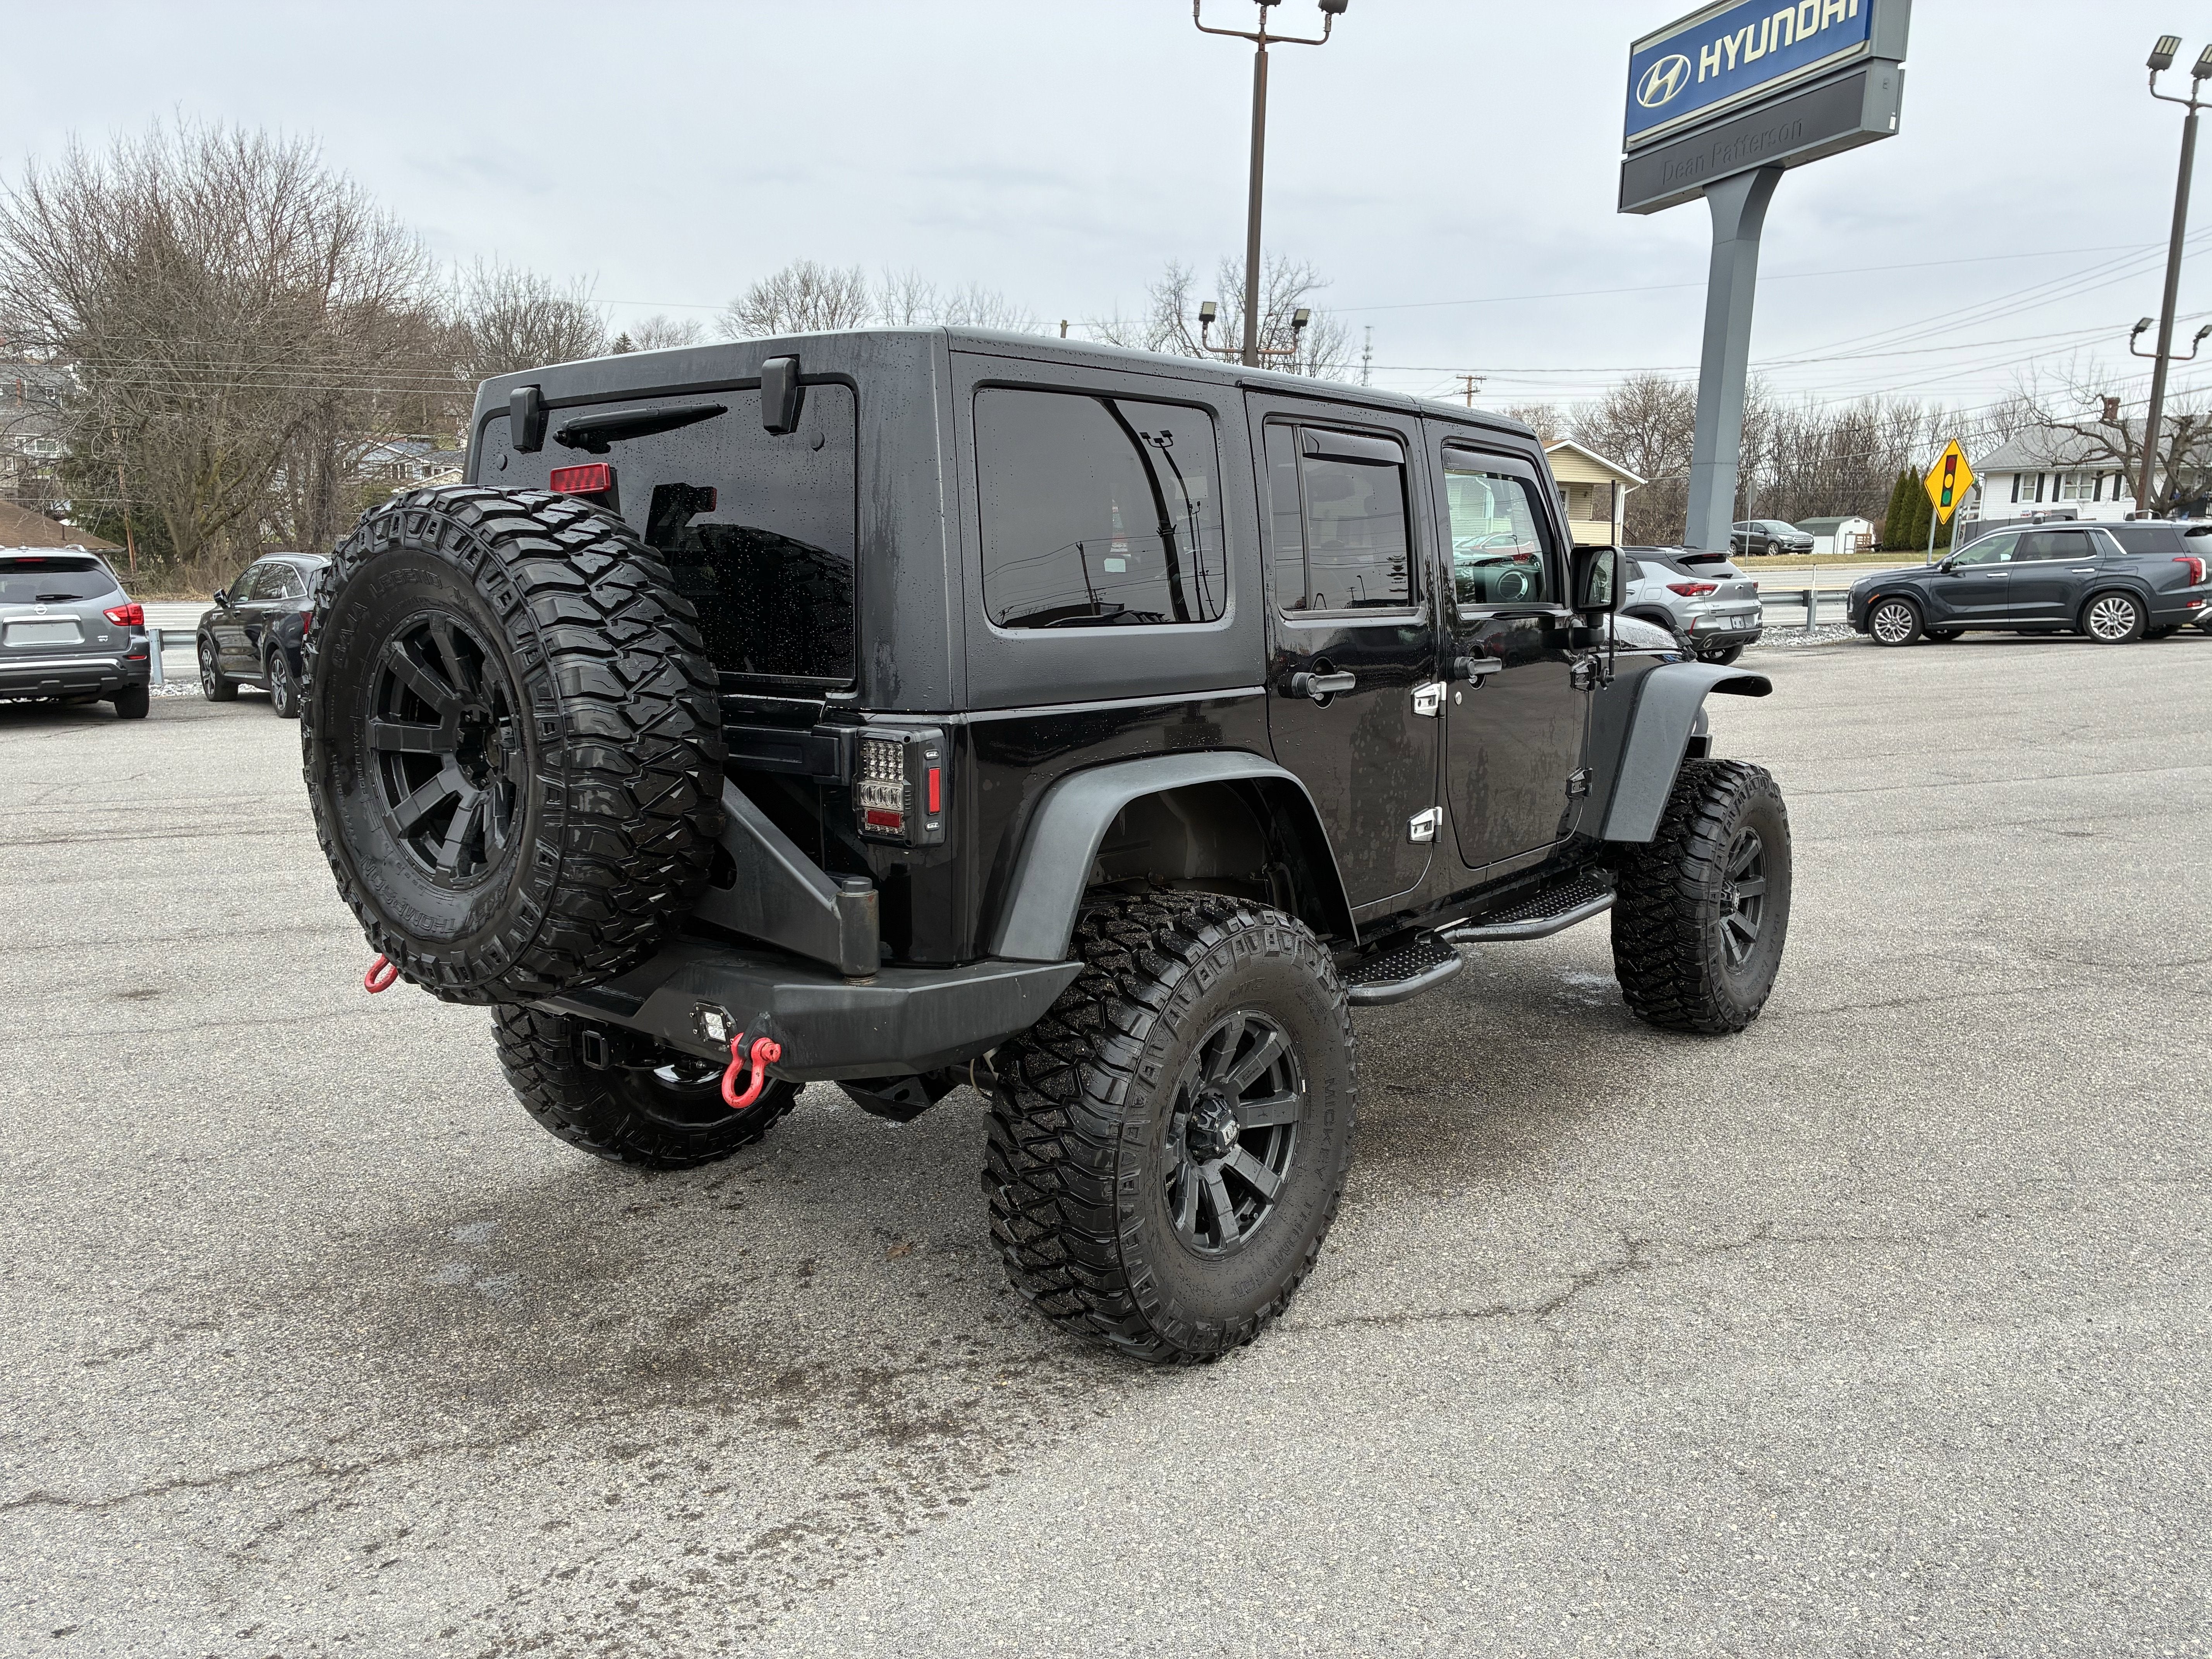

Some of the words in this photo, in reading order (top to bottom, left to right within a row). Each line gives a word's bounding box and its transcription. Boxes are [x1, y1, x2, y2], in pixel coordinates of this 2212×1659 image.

[1662, 153, 1704, 185] Dean
[1711, 118, 1803, 168] Patterson
[369, 568, 443, 597] LEGEND
[1315, 1077, 1335, 1182] MICKEY
